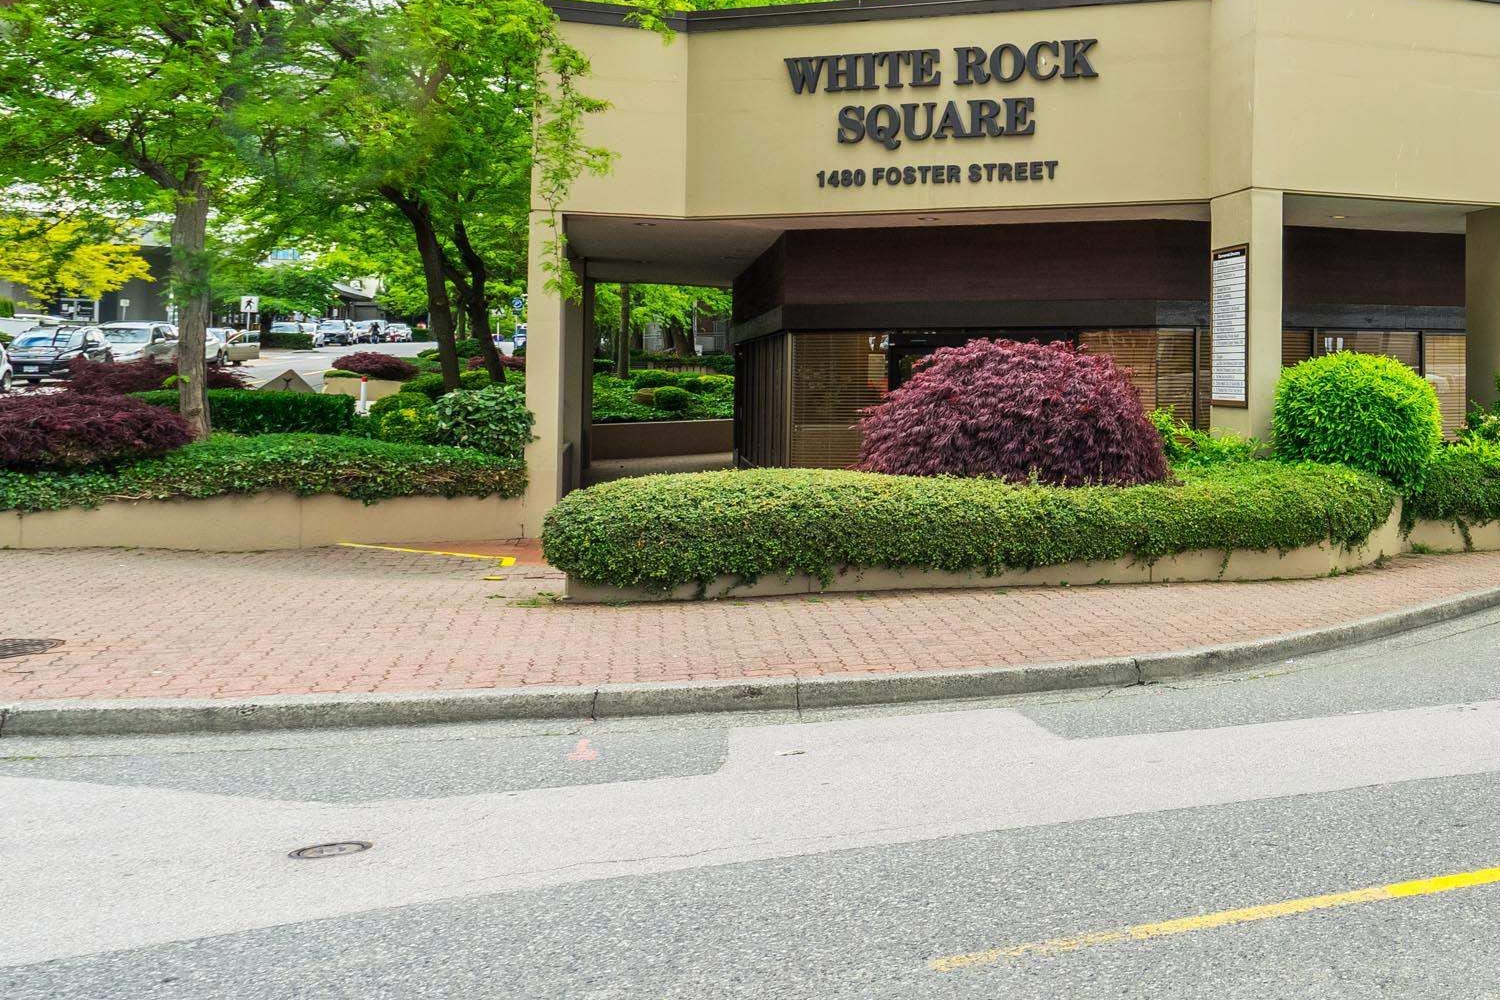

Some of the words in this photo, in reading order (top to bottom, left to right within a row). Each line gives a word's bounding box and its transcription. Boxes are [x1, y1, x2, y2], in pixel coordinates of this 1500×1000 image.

[784, 48, 941, 95] WHITE
[953, 38, 1099, 85] ROCK
[837, 97, 1036, 150] SQUARE
[816, 170, 866, 188] 1480
[872, 165, 961, 186] FOSTER
[967, 160, 1059, 183] STREET
